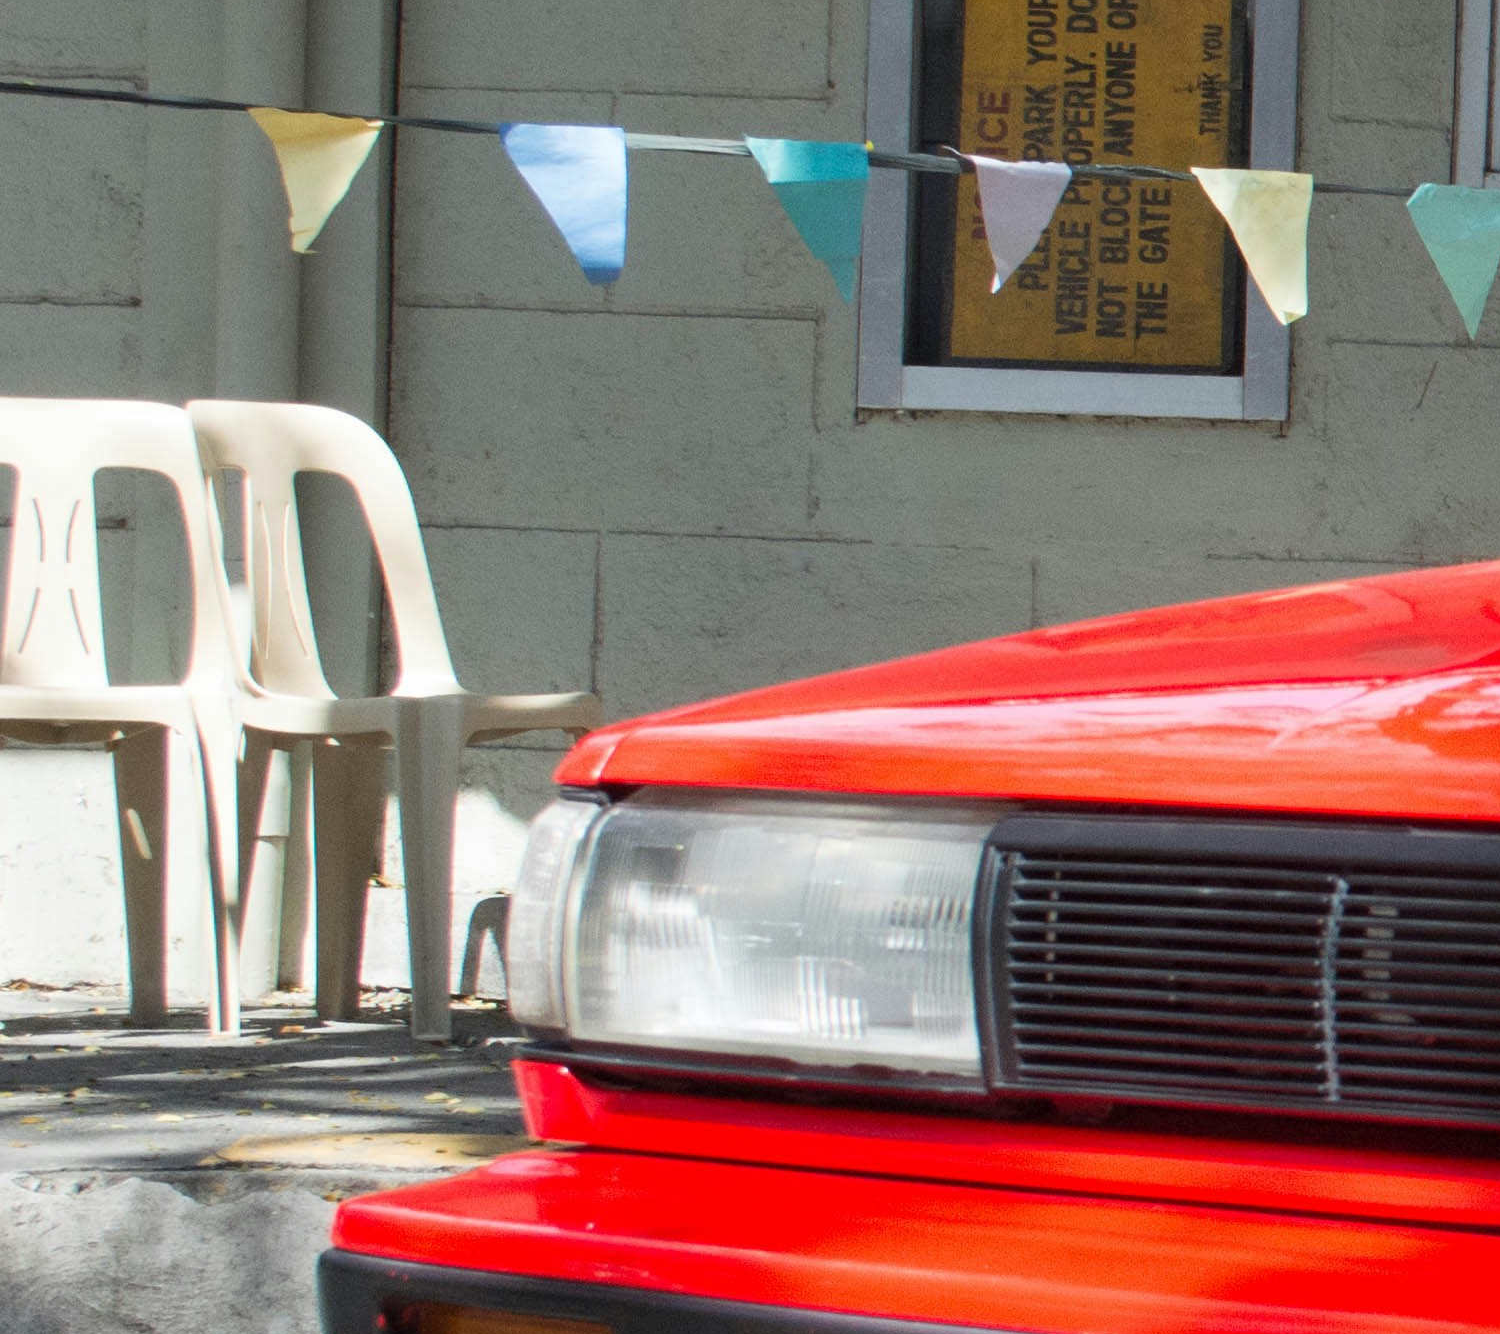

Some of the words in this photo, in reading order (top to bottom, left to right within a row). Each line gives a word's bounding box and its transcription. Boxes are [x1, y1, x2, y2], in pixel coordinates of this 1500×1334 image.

[1201, 24, 1225, 66] YOU
[1023, 83, 1058, 164] PARK
[1103, 41, 1138, 158] ANYONE
[1199, 73, 1225, 136] THANK
[970, 90, 1012, 241] ICE
[1054, 219, 1092, 336] VEHICLE
[1095, 277, 1130, 339] NOT
[1135, 281, 1170, 340] THE
